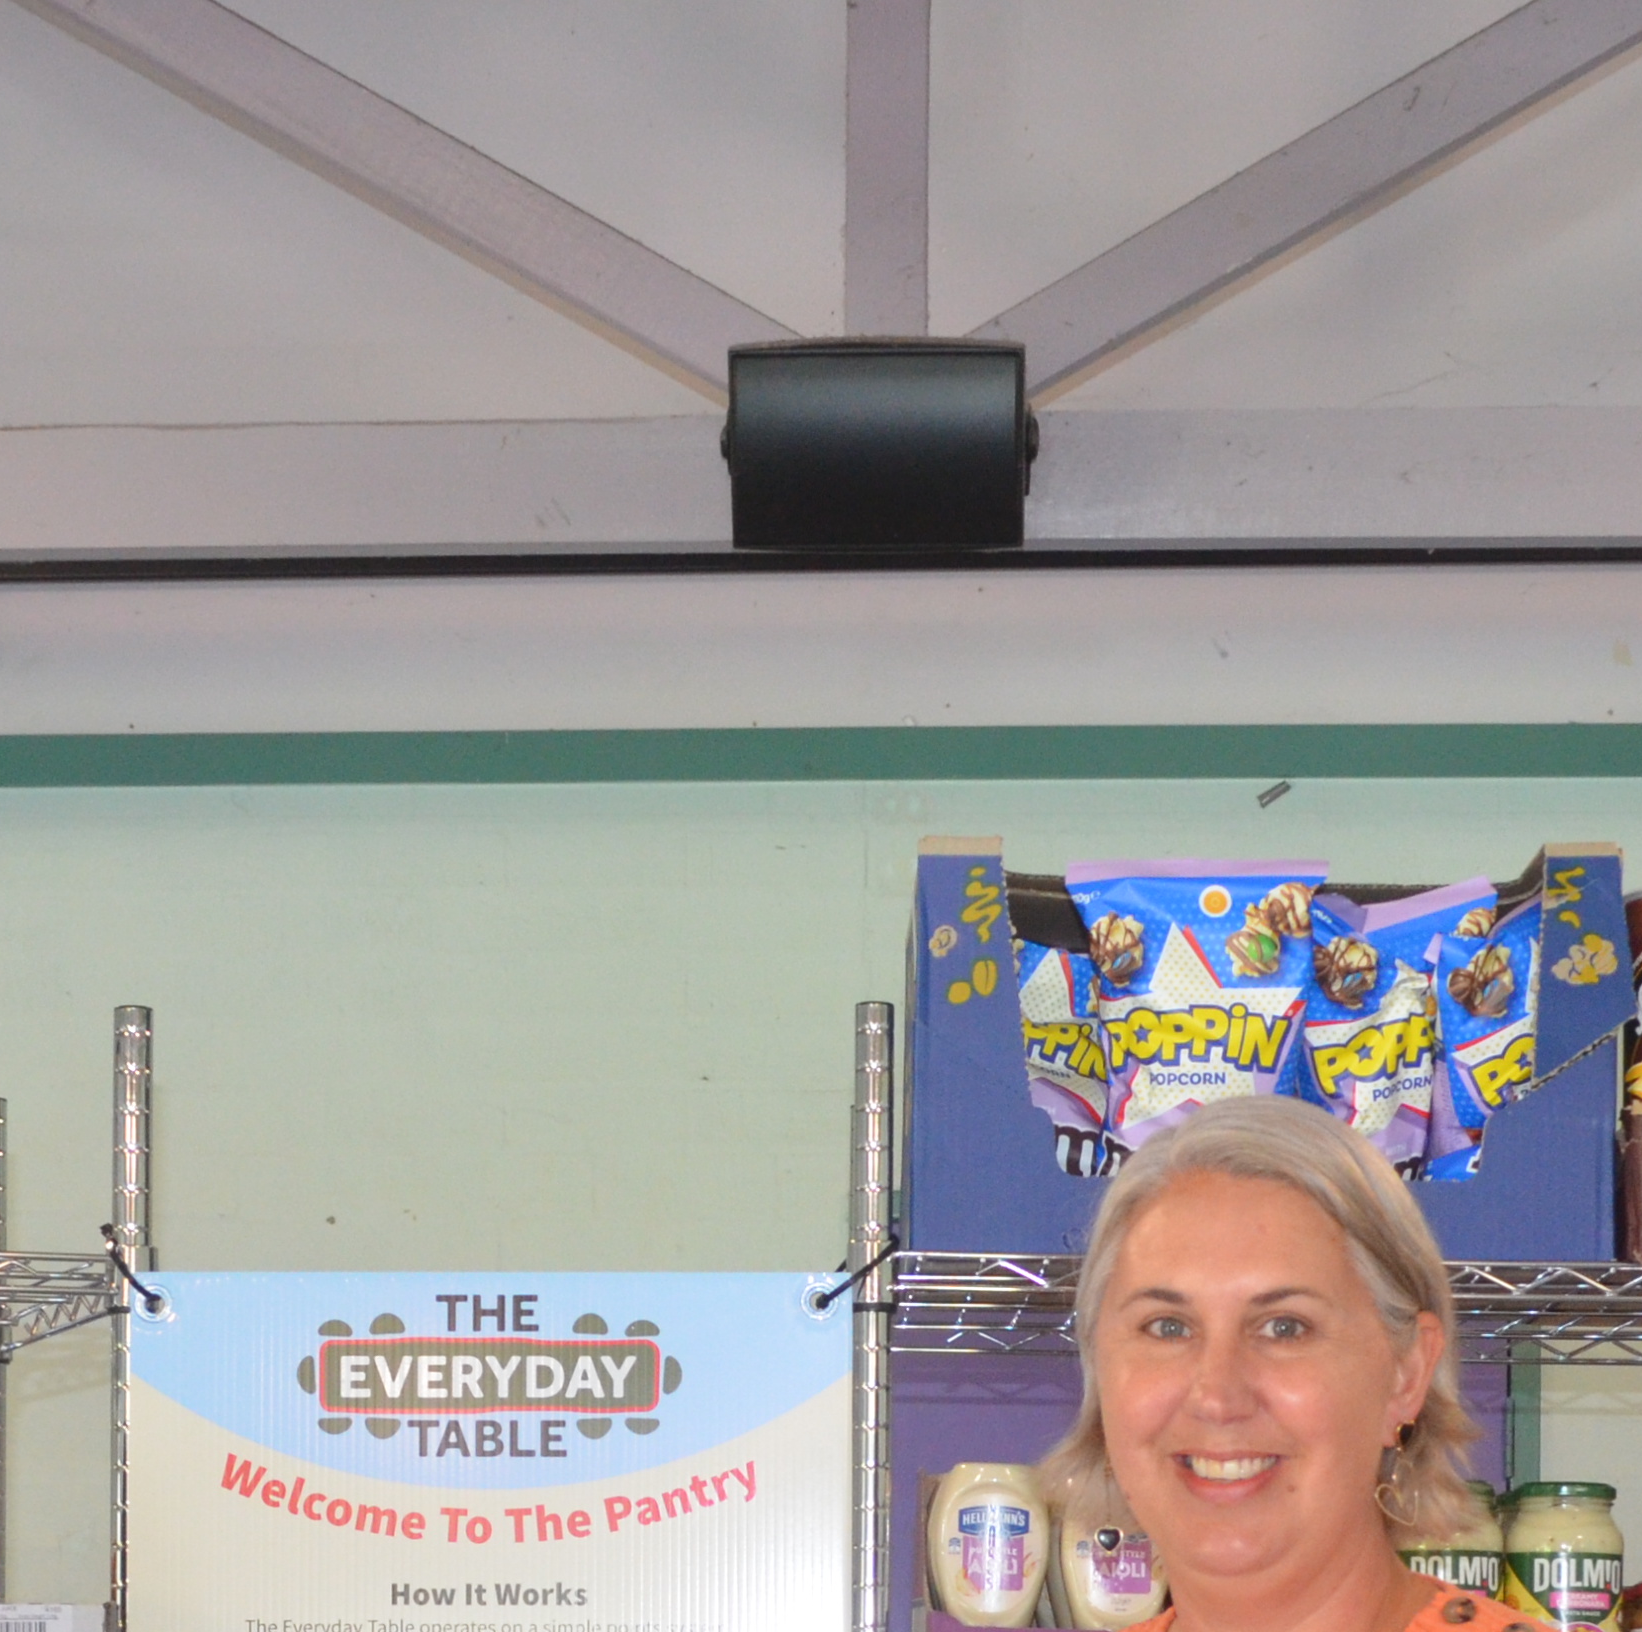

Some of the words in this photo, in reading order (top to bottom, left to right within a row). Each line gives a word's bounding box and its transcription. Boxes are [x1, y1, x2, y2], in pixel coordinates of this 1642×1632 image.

[1149, 1071, 1227, 1087] POPCORN
[436, 1294, 539, 1332] THE
[339, 1354, 637, 1399] EVERYDAY
[407, 1420, 567, 1458] TABLE
[220, 1453, 427, 1540] Welcome
[440, 1508, 493, 1544] To
[505, 1505, 592, 1544] The
[605, 1461, 759, 1533] Pantry
[391, 1582, 456, 1607] How
[465, 1583, 487, 1606] It
[494, 1581, 588, 1607] Works
